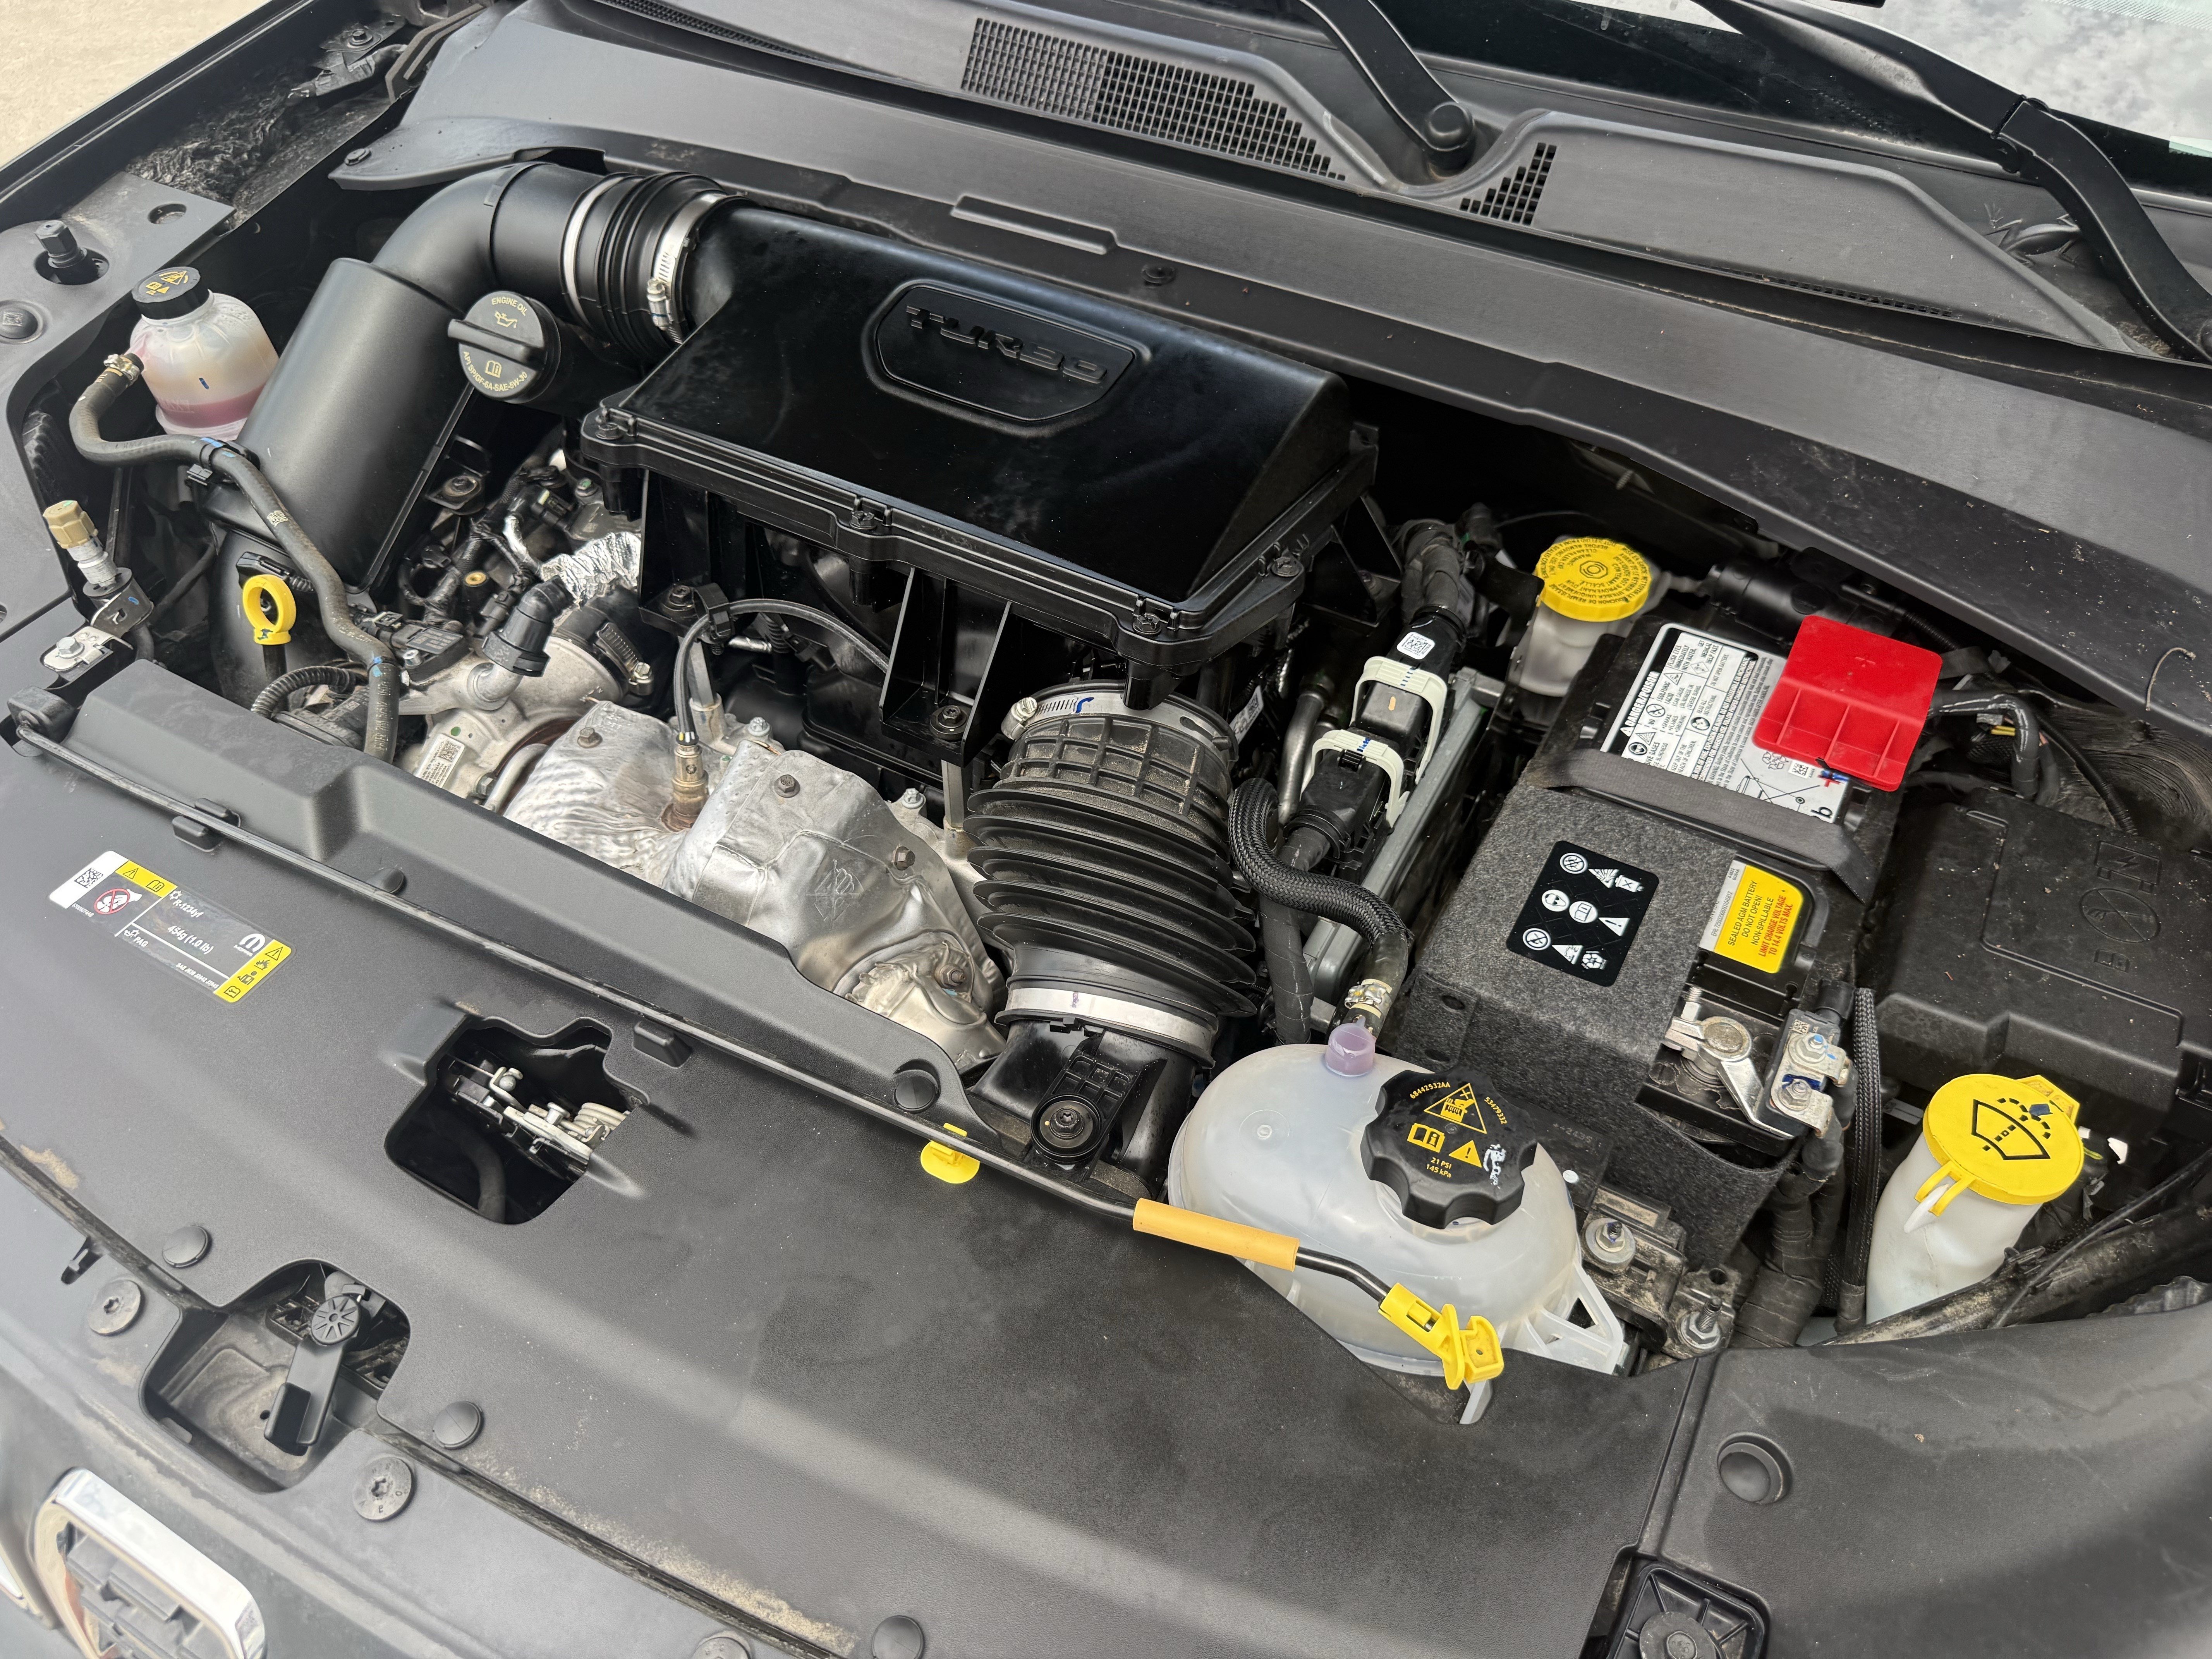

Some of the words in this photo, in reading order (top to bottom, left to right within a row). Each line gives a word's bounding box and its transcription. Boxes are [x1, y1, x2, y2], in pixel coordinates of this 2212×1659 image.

[491, 297, 517, 307] ENGINE
[517, 304, 528, 316] OIL
[906, 306, 1107, 383] TURBO
[464, 351, 472, 365] API
[1666, 654, 1677, 666] FLUSH
[1673, 645, 1681, 654] EYES
[1673, 645, 1690, 668] IMMEDIATELY
[1700, 642, 1712, 658] MEDICAL
[1680, 661, 1690, 671] WITH
[1685, 647, 1697, 661] WATER.
[1705, 654, 1715, 664] HELP
[1714, 667, 1723, 676] OPEN
[1623, 670, 1662, 727] DANGER/POISON
[1656, 681, 1671, 700] SULFURIC
[1664, 692, 1674, 703] ACID
[1696, 705, 1704, 714] READ
[1648, 741, 1660, 755] GASES
[1711, 733, 1725, 750] INVERTED
[1692, 764, 1703, 774] RISK
[1702, 731, 1718, 750] EXPLOSION
[1708, 749, 1717, 757] FOR
[1670, 762, 1679, 771] KEEP
[172, 898, 204, 919] R-1234yf
[1728, 921, 1742, 946] SEALED
[1737, 907, 1747, 922] AGM
[1742, 880, 1757, 907] BATTERY
[1782, 903, 1793, 917] MAX.
[1745, 914, 1755, 927] NOT
[1750, 897, 1774, 945] NON-SPILLABLE
[1758, 940, 1769, 957] LIMIT
[1764, 919, 1778, 941] CHARGE
[1771, 895, 1786, 919] VOLTAGE
[1775, 917, 1788, 934] VOLTS
[167, 924, 189, 941] 454g
[183, 934, 203, 947] (1.0
[199, 942, 214, 954] lb)
[1741, 927, 1750, 937] DO
[1772, 934, 1782, 946] 14.4
[133, 936, 149, 947] PAG
[233, 944, 253, 957] MOPAR
[1410, 1082, 1451, 1099] 68442532AA
[1484, 1097, 1507, 1124] 53479332
[1426, 1164, 1438, 1173] 145
[1439, 1168, 1451, 1178] kPa
